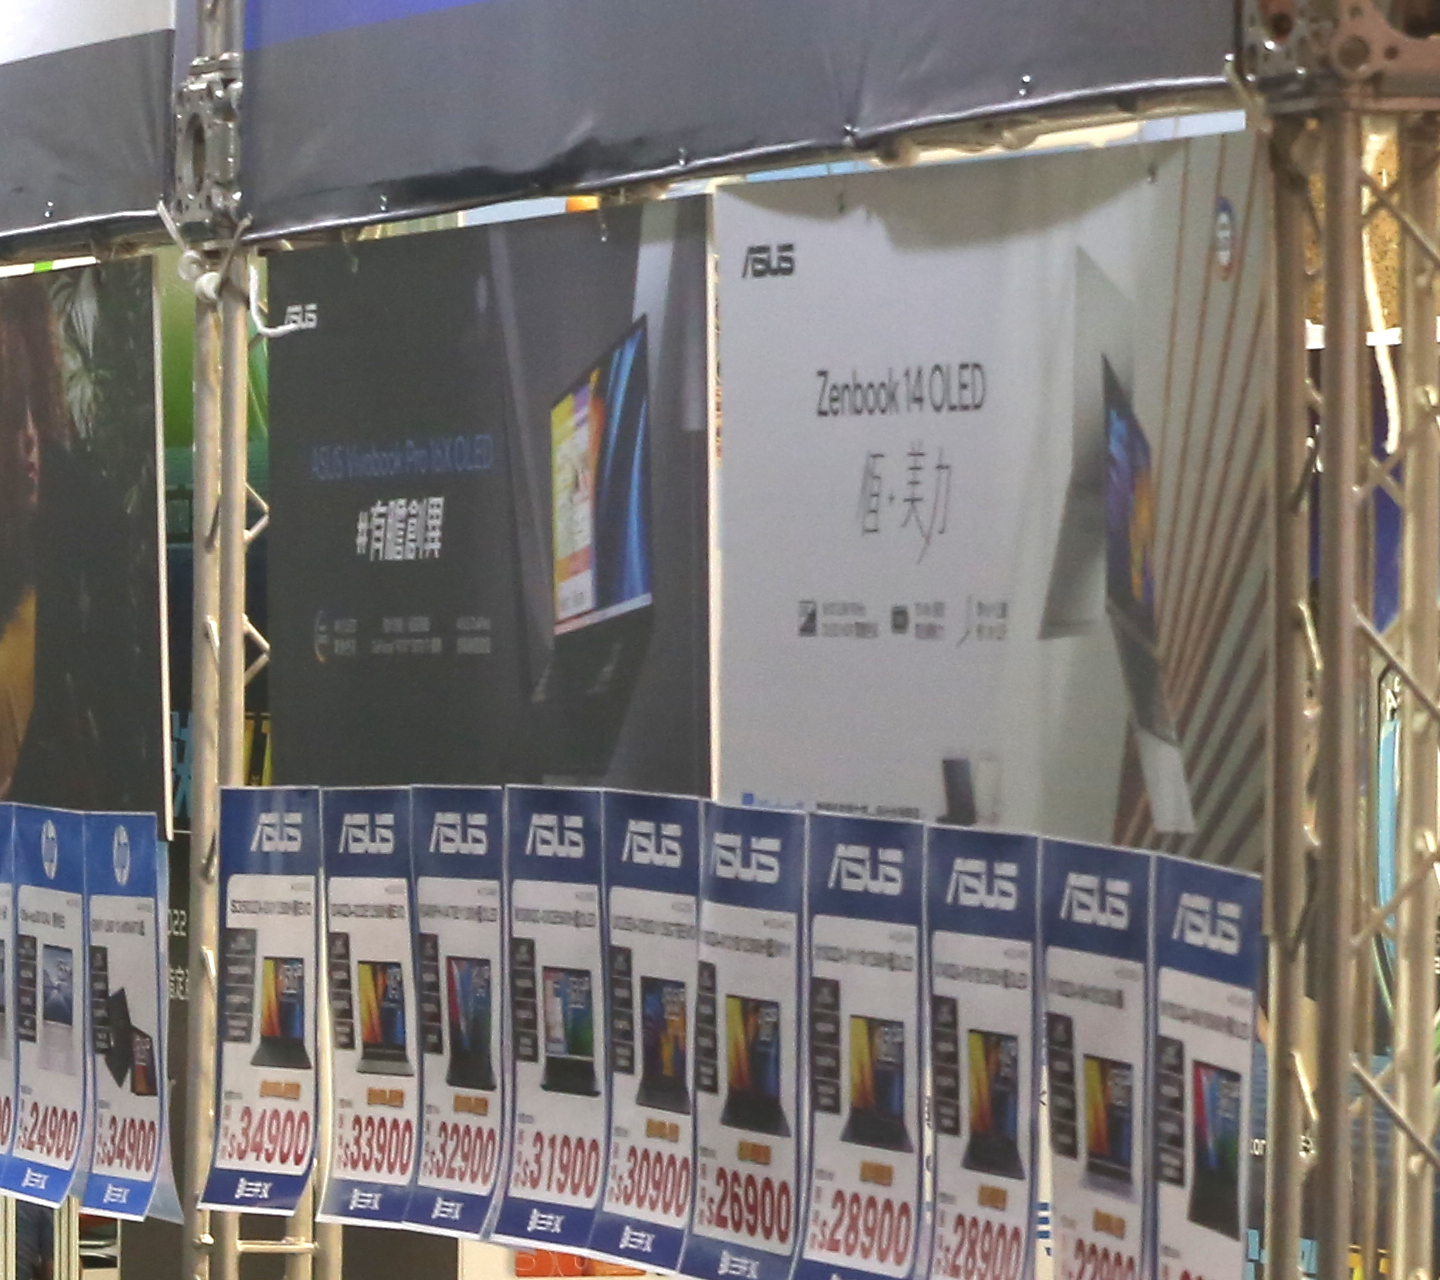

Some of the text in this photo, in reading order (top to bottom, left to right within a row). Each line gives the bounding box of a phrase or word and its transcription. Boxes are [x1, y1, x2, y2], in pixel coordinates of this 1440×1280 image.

[742, 243, 796, 278] ASUS
[816, 363, 987, 417] Zenbook 14 OLED
[251, 812, 303, 853] ASUS
[339, 812, 395, 855] ASUS
[428, 811, 489, 855] ASUS
[525, 813, 584, 859] ASUS
[621, 818, 683, 869] ASUS
[711, 831, 782, 883] ASUS
[827, 842, 905, 896] ASUS
[945, 857, 1019, 912] ASUS
[1059, 870, 1132, 932] ASUS
[1172, 892, 1242, 956] ASUS
